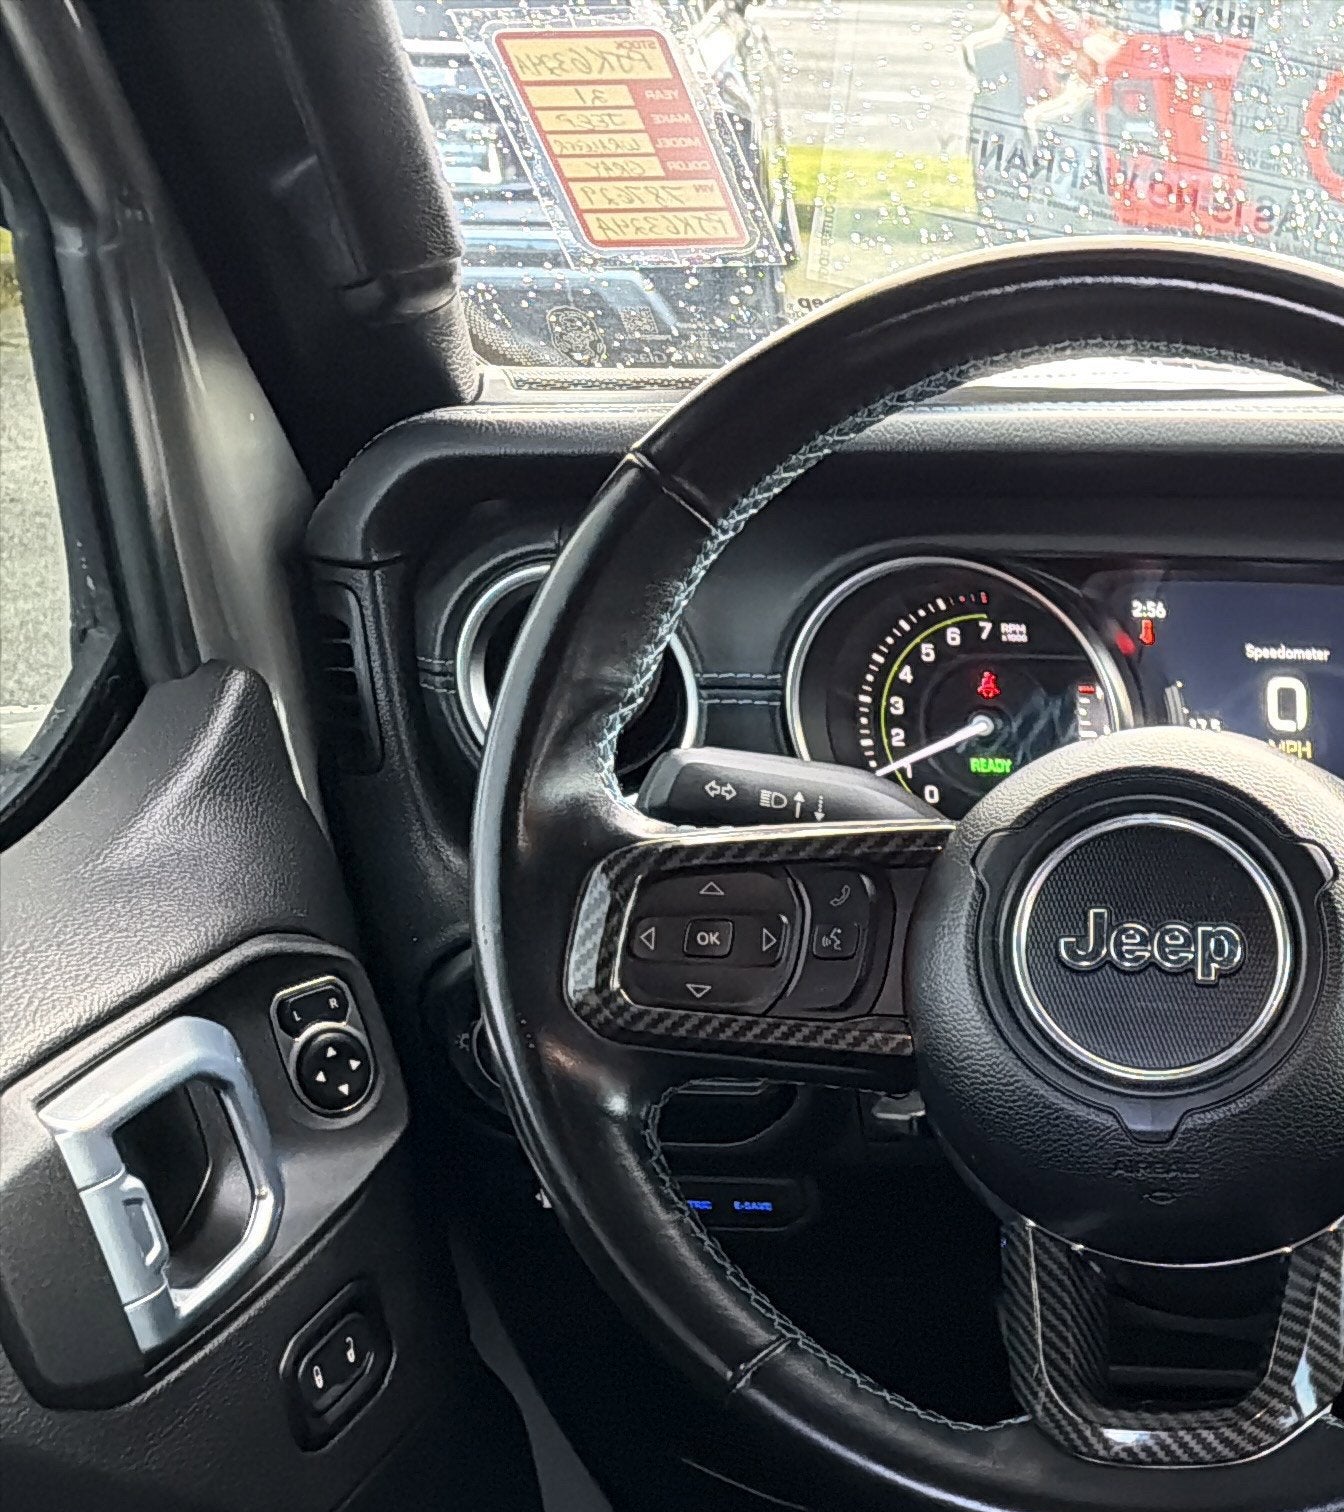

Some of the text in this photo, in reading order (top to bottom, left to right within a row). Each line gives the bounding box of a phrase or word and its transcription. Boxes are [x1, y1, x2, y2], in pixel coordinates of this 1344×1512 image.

[1129, 599, 1168, 619] 2:56
[945, 627, 962, 647] 6
[979, 622, 994, 640] 7
[1000, 622, 1028, 634] RPM
[919, 643, 937, 663] 5
[1244, 643, 1330, 662] Speedometer
[898, 664, 914, 684] 4
[888, 697, 905, 716] 3
[1265, 675, 1309, 734] 0
[889, 728, 906, 747] 2
[970, 757, 1013, 775] READY
[924, 784, 940, 804] 0
[695, 931, 722, 947] OK
[1058, 906, 1243, 984] Jeep
[328, 997, 340, 1009] R
